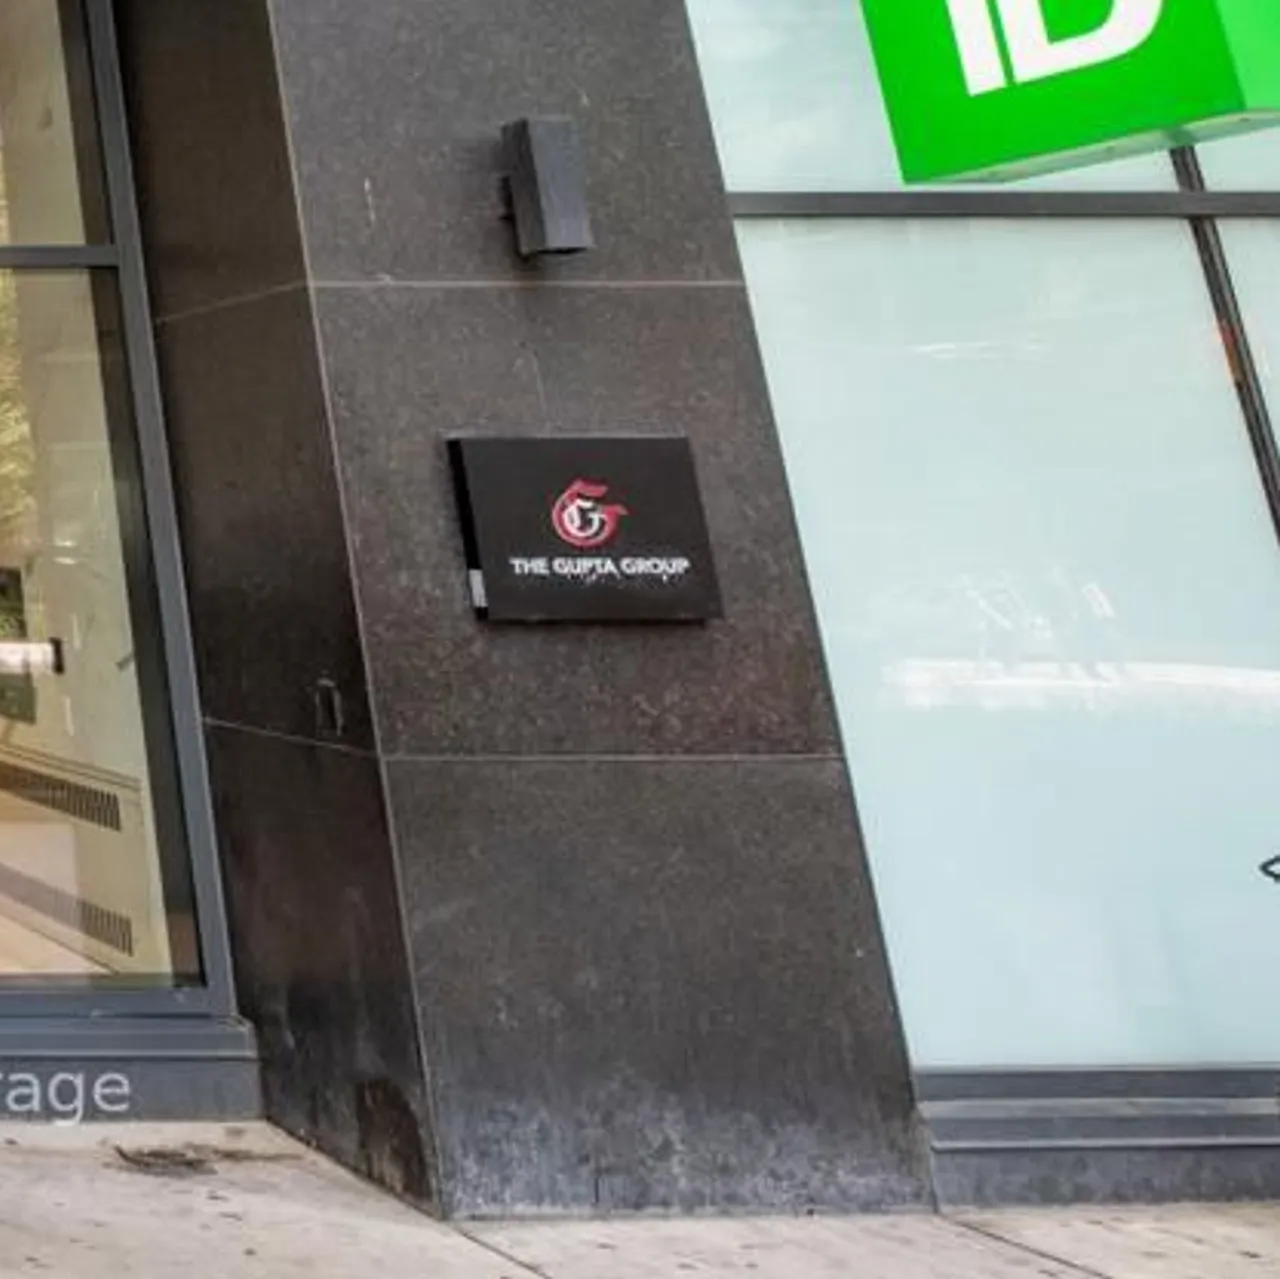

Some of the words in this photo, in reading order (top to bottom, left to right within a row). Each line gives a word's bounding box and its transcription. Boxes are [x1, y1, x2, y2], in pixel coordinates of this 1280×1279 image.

[509, 556, 550, 575] THE
[552, 556, 620, 577] GUPTA
[620, 556, 691, 576] GROUP
